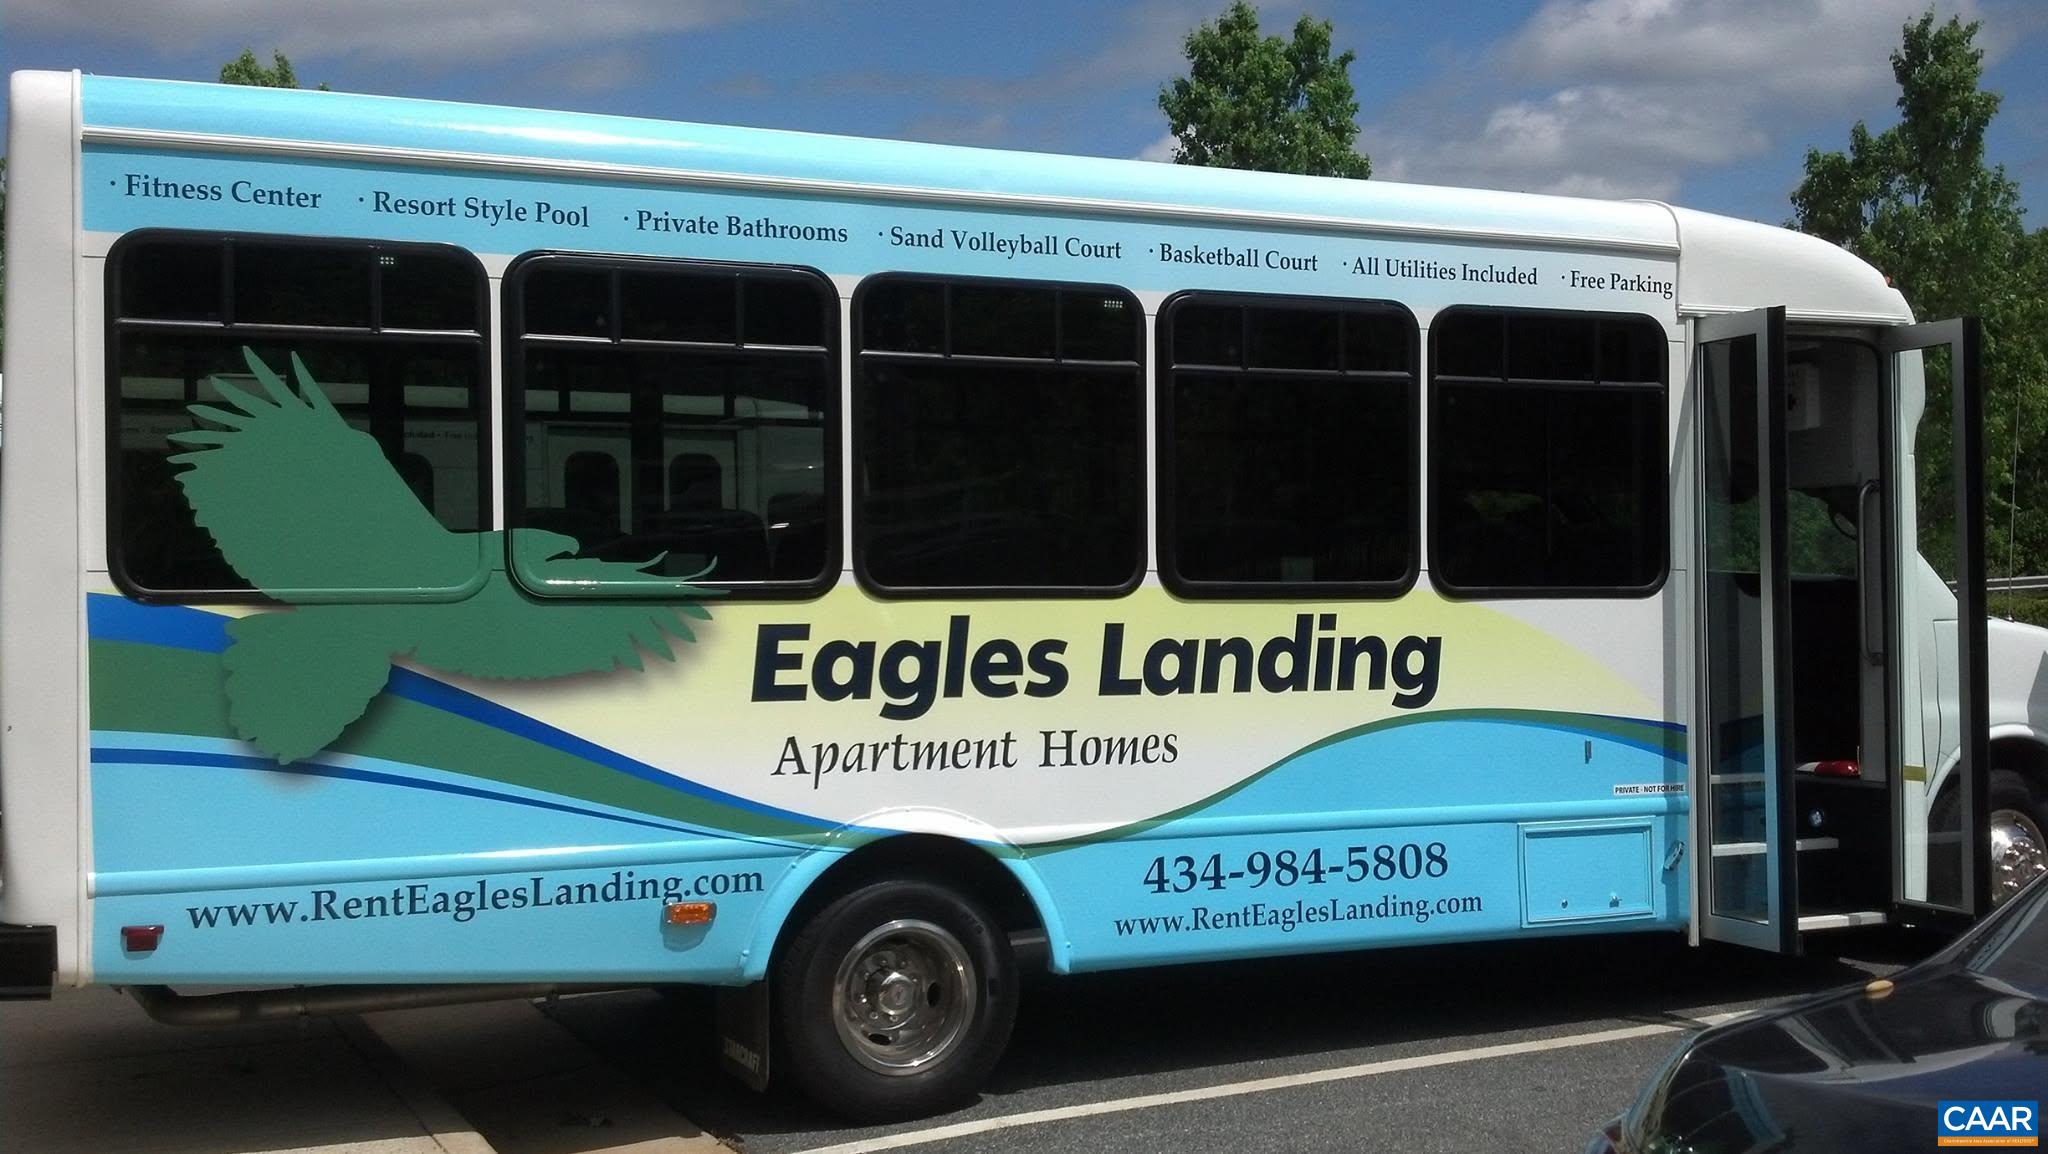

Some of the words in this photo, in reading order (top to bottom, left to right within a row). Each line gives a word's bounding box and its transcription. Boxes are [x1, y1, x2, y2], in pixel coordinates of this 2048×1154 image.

[124, 173, 223, 202] Fitness
[231, 180, 322, 209] Center
[372, 190, 457, 217] Resort
[464, 196, 528, 227] Style
[534, 201, 590, 228] Pool
[635, 209, 719, 235] Private
[725, 215, 849, 243] Bathrooms
[890, 225, 945, 249] Sand
[949, 229, 1059, 261] Volleyball
[1064, 237, 1122, 260] Court
[1159, 242, 1260, 268] Basketball
[1265, 250, 1319, 272] Court
[1351, 256, 1380, 276] All
[1384, 258, 1457, 281] Utilities
[1461, 263, 1538, 286] Included
[1570, 270, 1606, 290] Free
[1610, 273, 1674, 299] Parking
[751, 615, 1070, 721] Eagles
[1098, 613, 1442, 710] Landing
[771, 732, 1018, 790] Apartment
[1039, 729, 1179, 768] Homes
[1614, 786, 1640, 794] PRIVATE
[1643, 785, 1657, 793] NOT
[1657, 784, 1670, 792] FOR
[1670, 784, 1685, 792] HIRE
[1143, 841, 1449, 895] 434-984-5808
[186, 871, 765, 929] www.RentEaglesLanding.com
[1114, 893, 1483, 936] www.RentEaglesLanding.com
